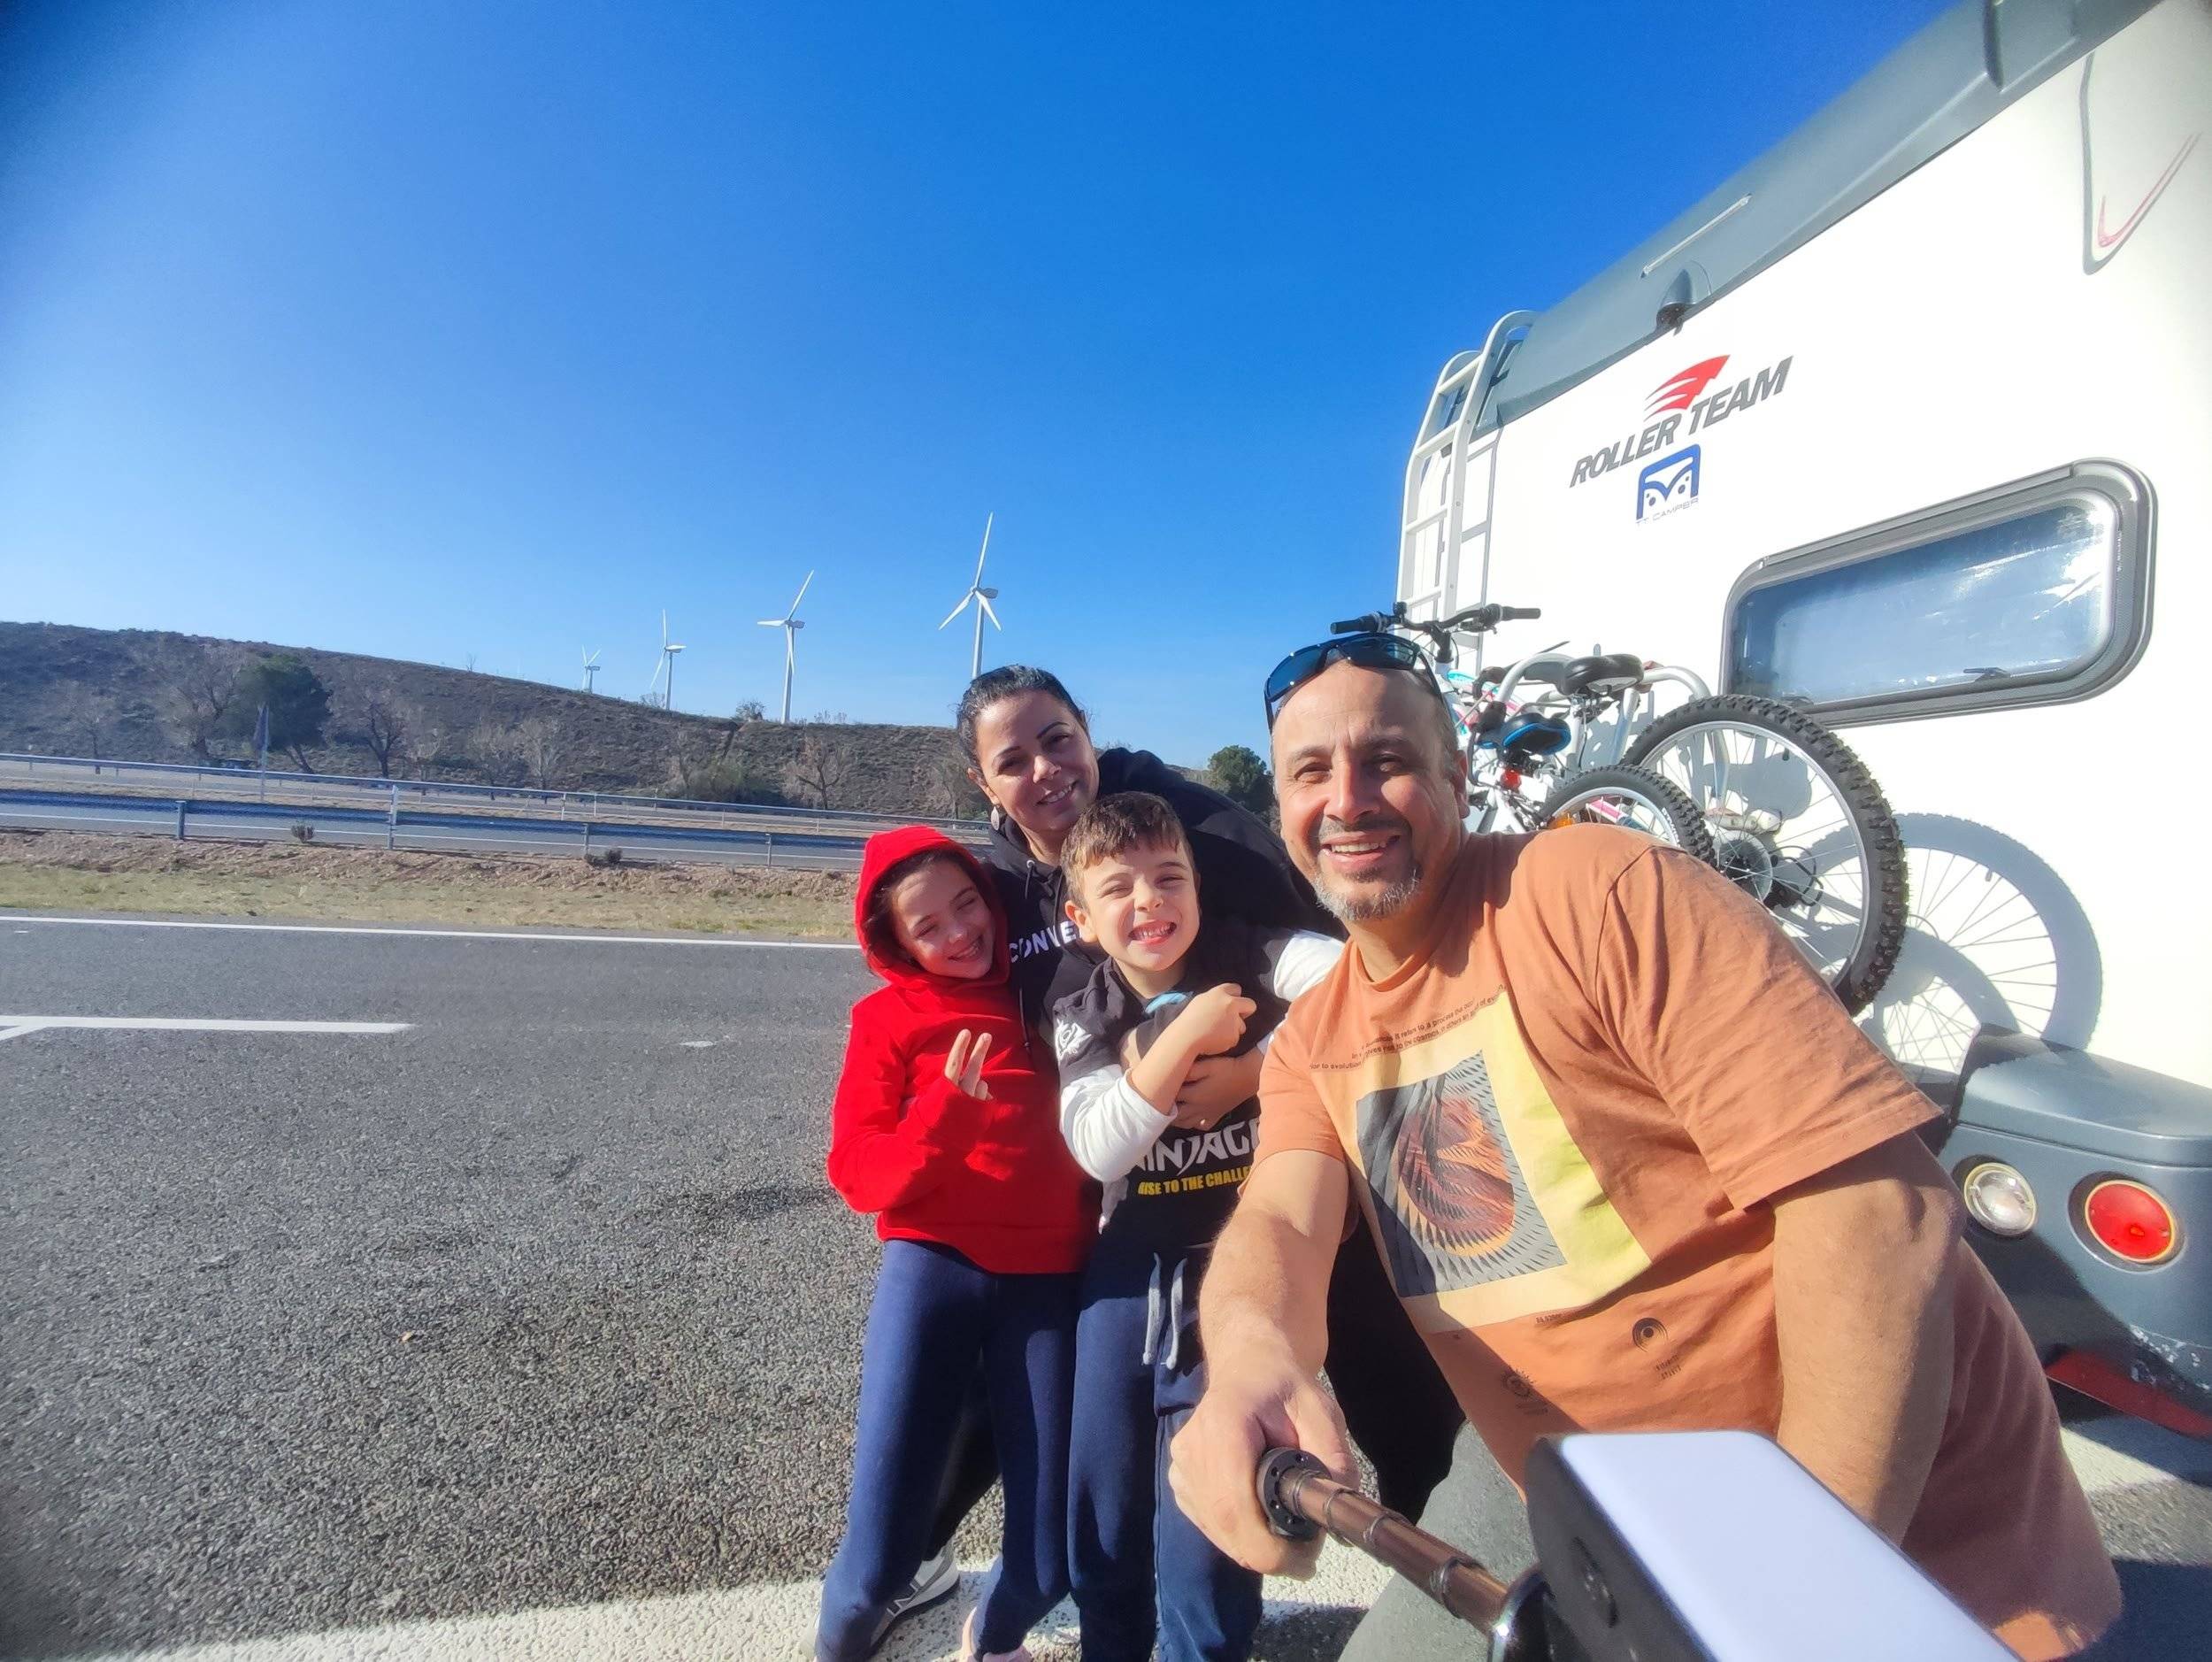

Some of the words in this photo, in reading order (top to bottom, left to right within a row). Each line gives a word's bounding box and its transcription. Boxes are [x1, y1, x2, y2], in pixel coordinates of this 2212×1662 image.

[1570, 413, 1682, 489] ROLLER
[1688, 355, 1793, 435] TEAM
[1652, 497, 1700, 521] CAMPER
[1010, 920, 1078, 964] CONVE
[1136, 1117, 1260, 1177] INJAG
[1164, 1179, 1179, 1194] TO
[1182, 1174, 1204, 1191] THE
[1205, 1165, 1251, 1188] CHALLE
